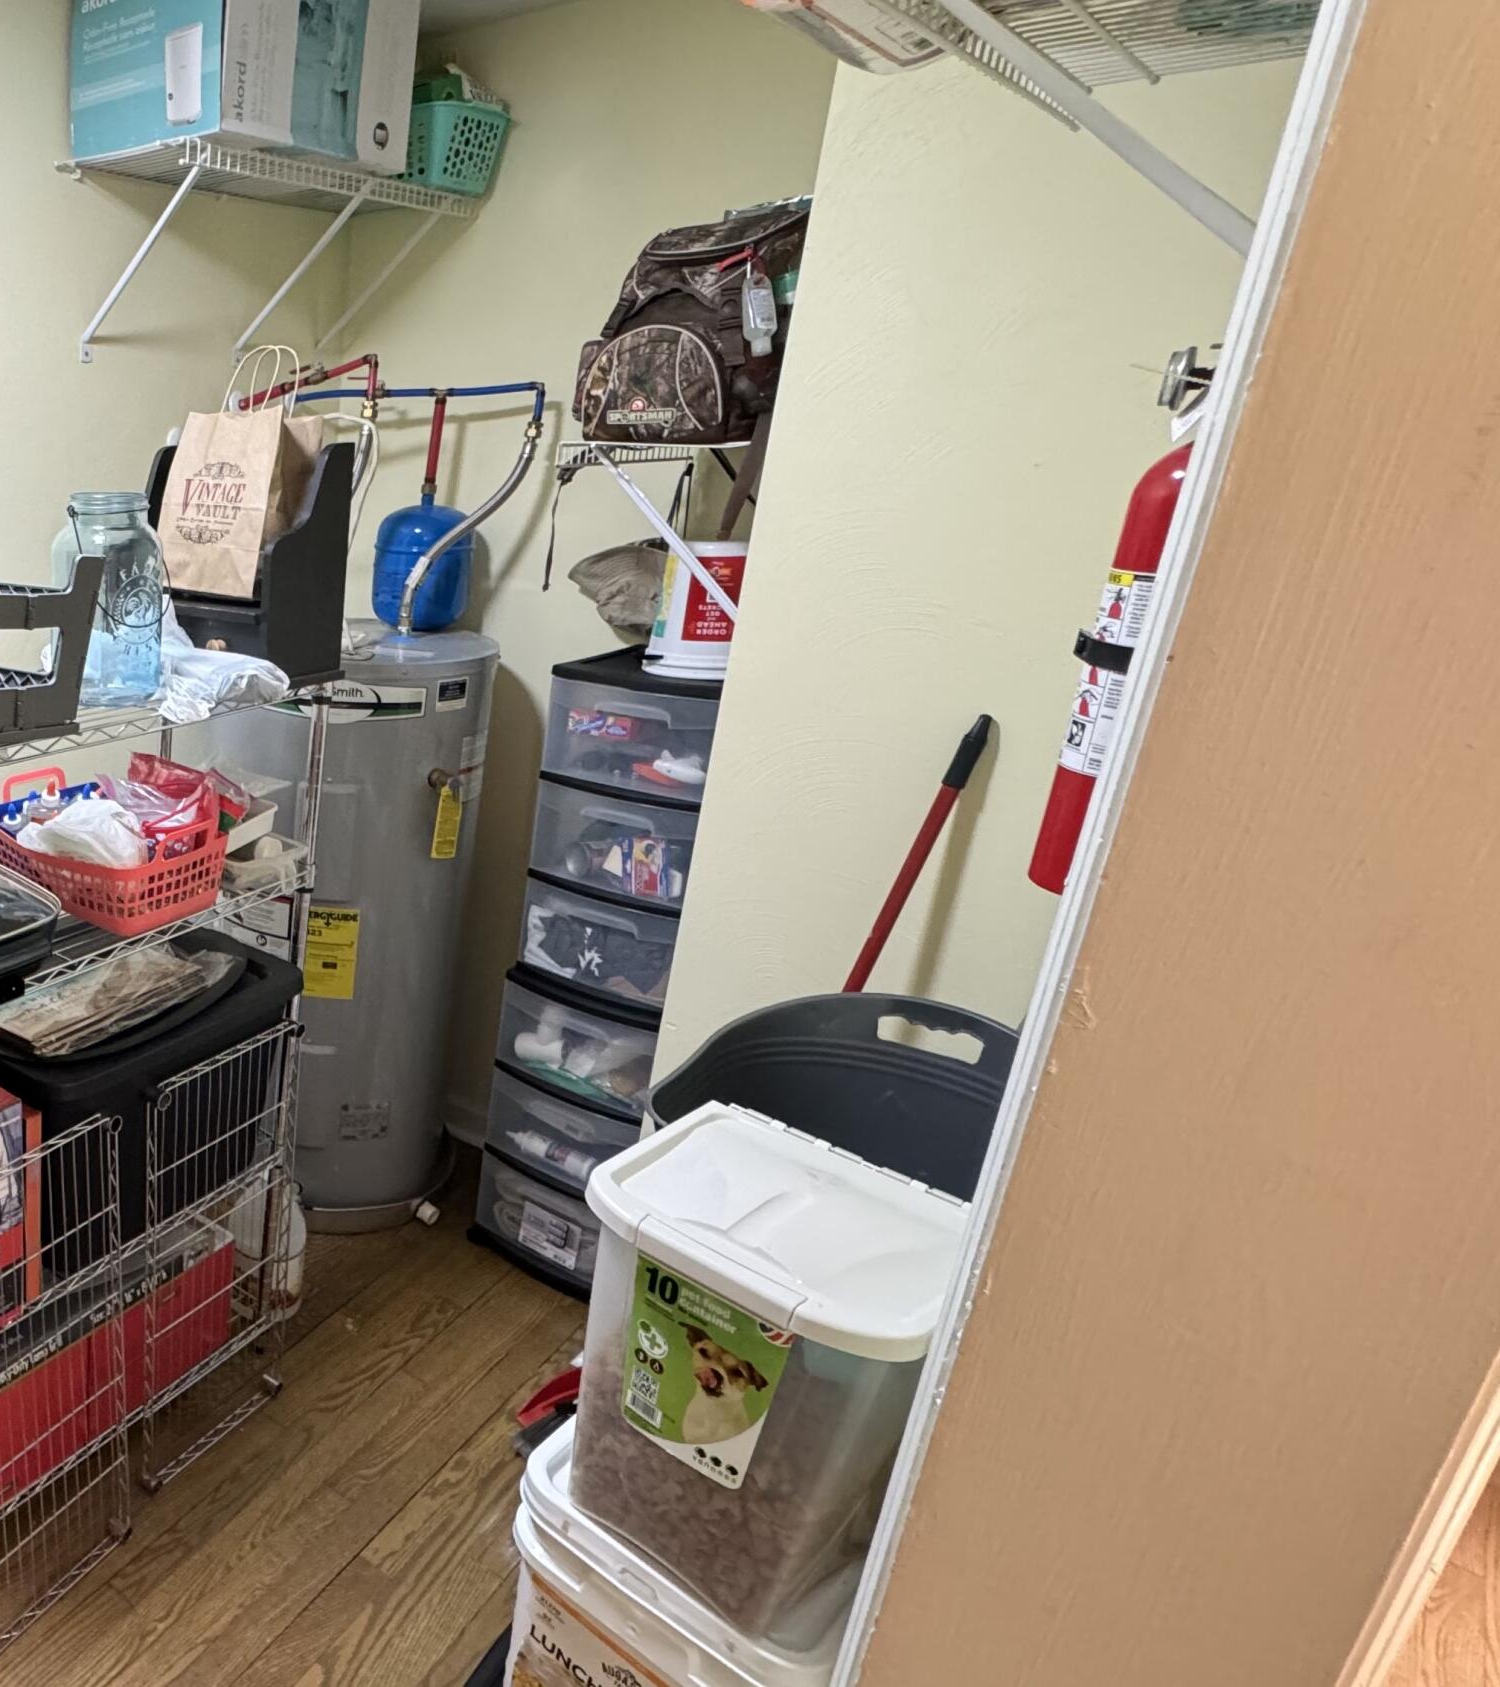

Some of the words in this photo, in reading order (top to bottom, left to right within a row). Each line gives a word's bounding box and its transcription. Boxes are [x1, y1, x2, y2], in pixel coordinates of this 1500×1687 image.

[608, 410, 672, 422] SPORTSMAN
[182, 478, 246, 516] VINTAGE
[195, 503, 241, 520] VAULT
[696, 628, 727, 636] ORDER
[308, 911, 358, 926] ERGYGUIDE
[645, 1266, 679, 1306] 10
